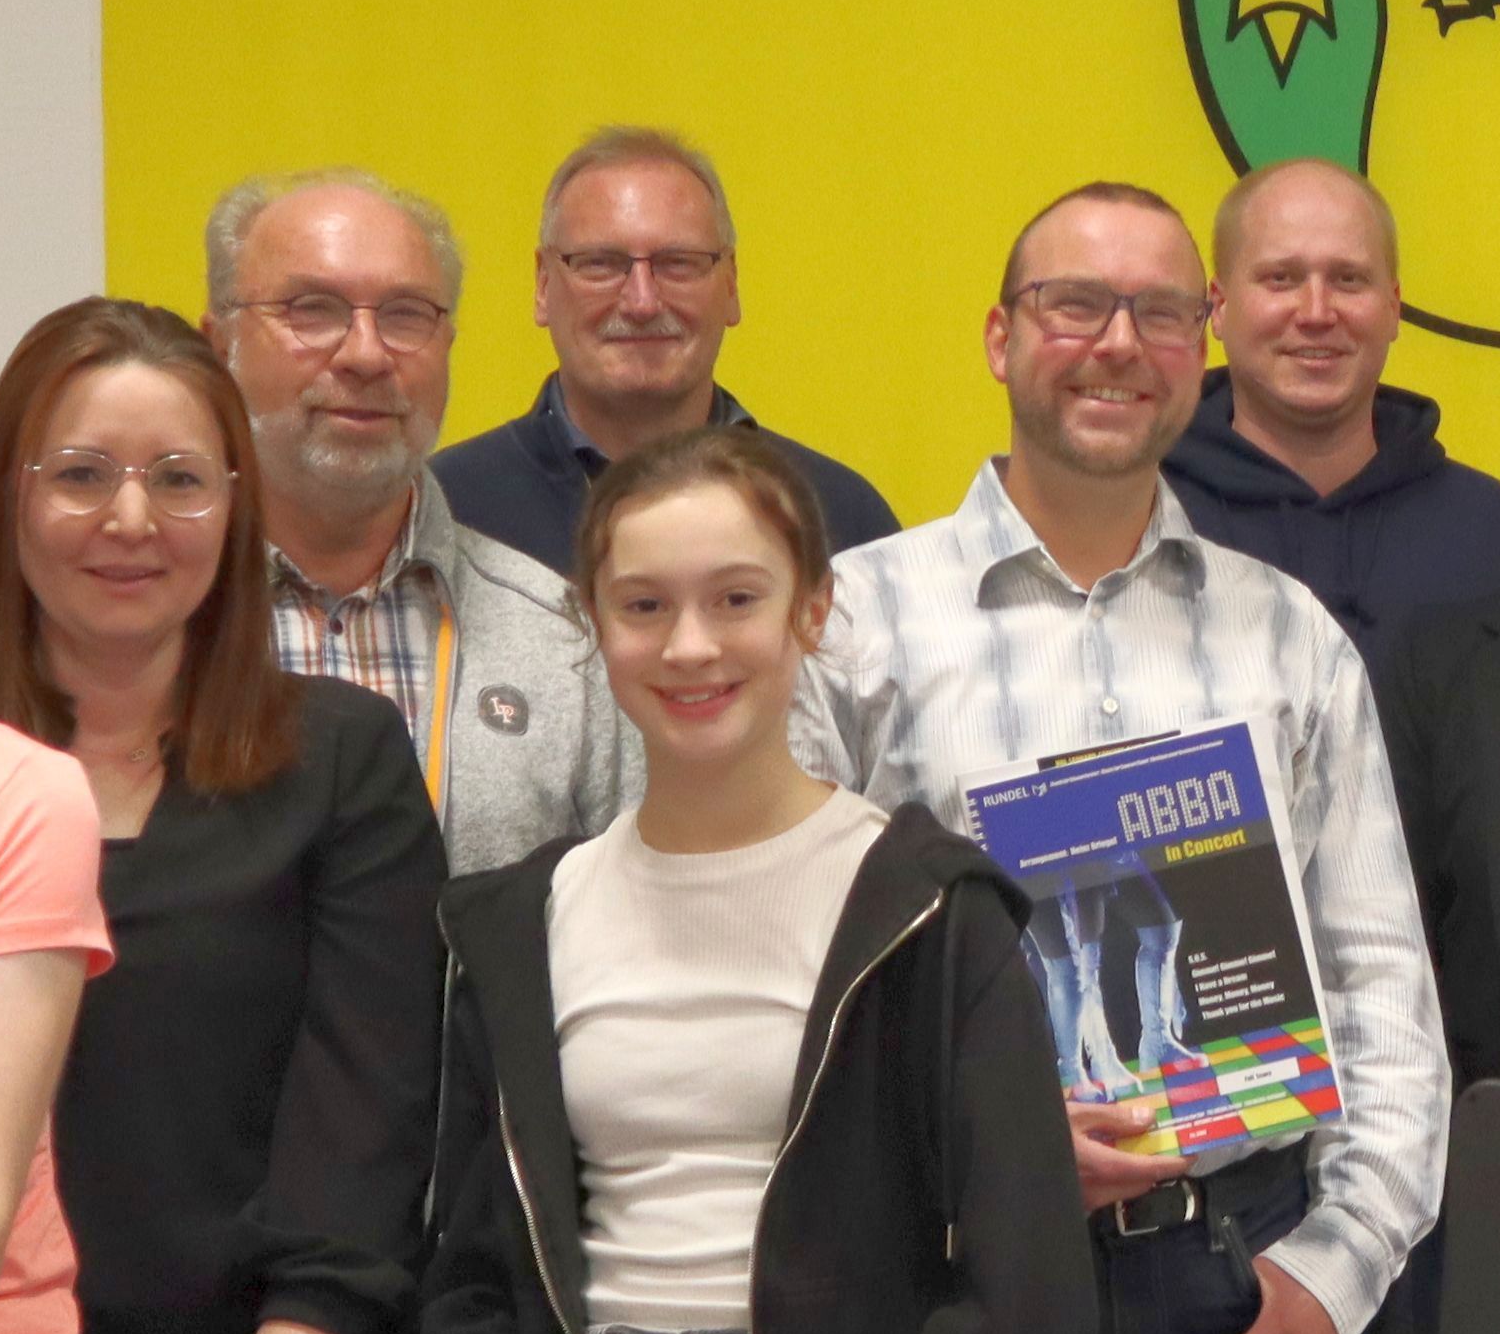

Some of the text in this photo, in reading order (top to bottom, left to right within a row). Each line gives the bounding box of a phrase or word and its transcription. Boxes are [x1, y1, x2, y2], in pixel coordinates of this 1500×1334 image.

[983, 786, 1030, 808] RUNDEL
[1117, 770, 1241, 843] ABBA
[1182, 828, 1247, 860] Concert
